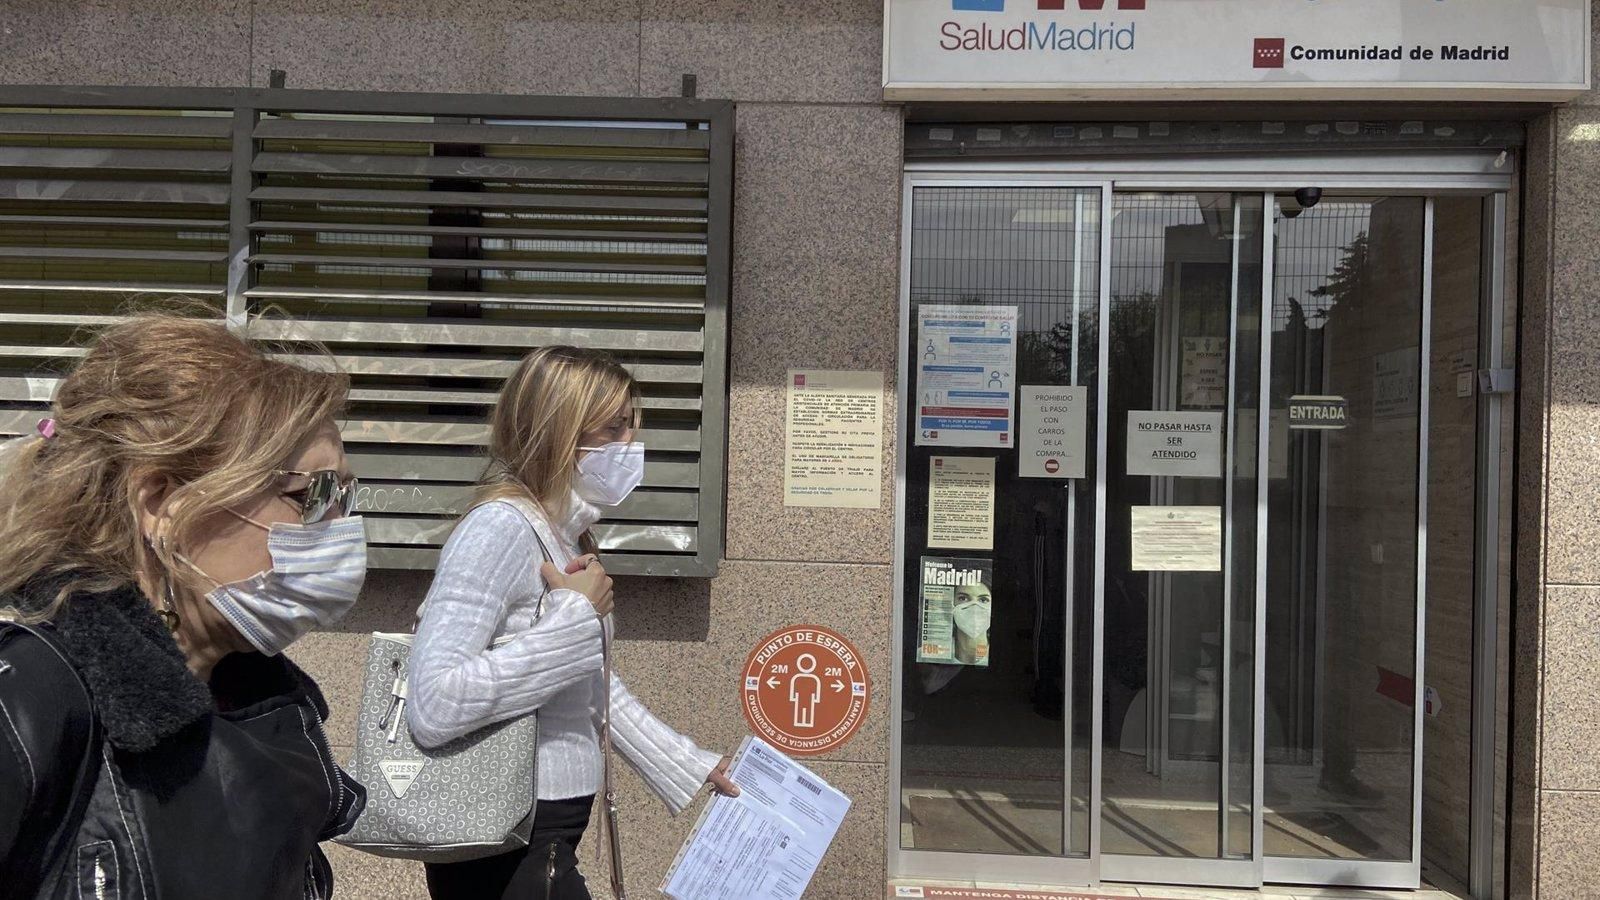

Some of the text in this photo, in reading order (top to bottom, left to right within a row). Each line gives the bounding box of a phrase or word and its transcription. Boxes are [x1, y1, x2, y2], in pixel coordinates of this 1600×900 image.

[940, 22, 1135, 51] SaludMadrid
[1290, 45, 1510, 62] Comunidad de Madrid
[1290, 406, 1345, 419] ENTRADA
[1152, 450, 1197, 458] ATENDIDO
[924, 568, 982, 586] Madrid!
[756, 632, 857, 670] PUNTO DE ESPERA
[772, 664, 788, 674] 2M
[824, 668, 842, 676] 2M
[748, 694, 861, 748] MANTENGA DISTANCIA DE SEGURIDAD
[930, 890, 1012, 898] MANTENGA
